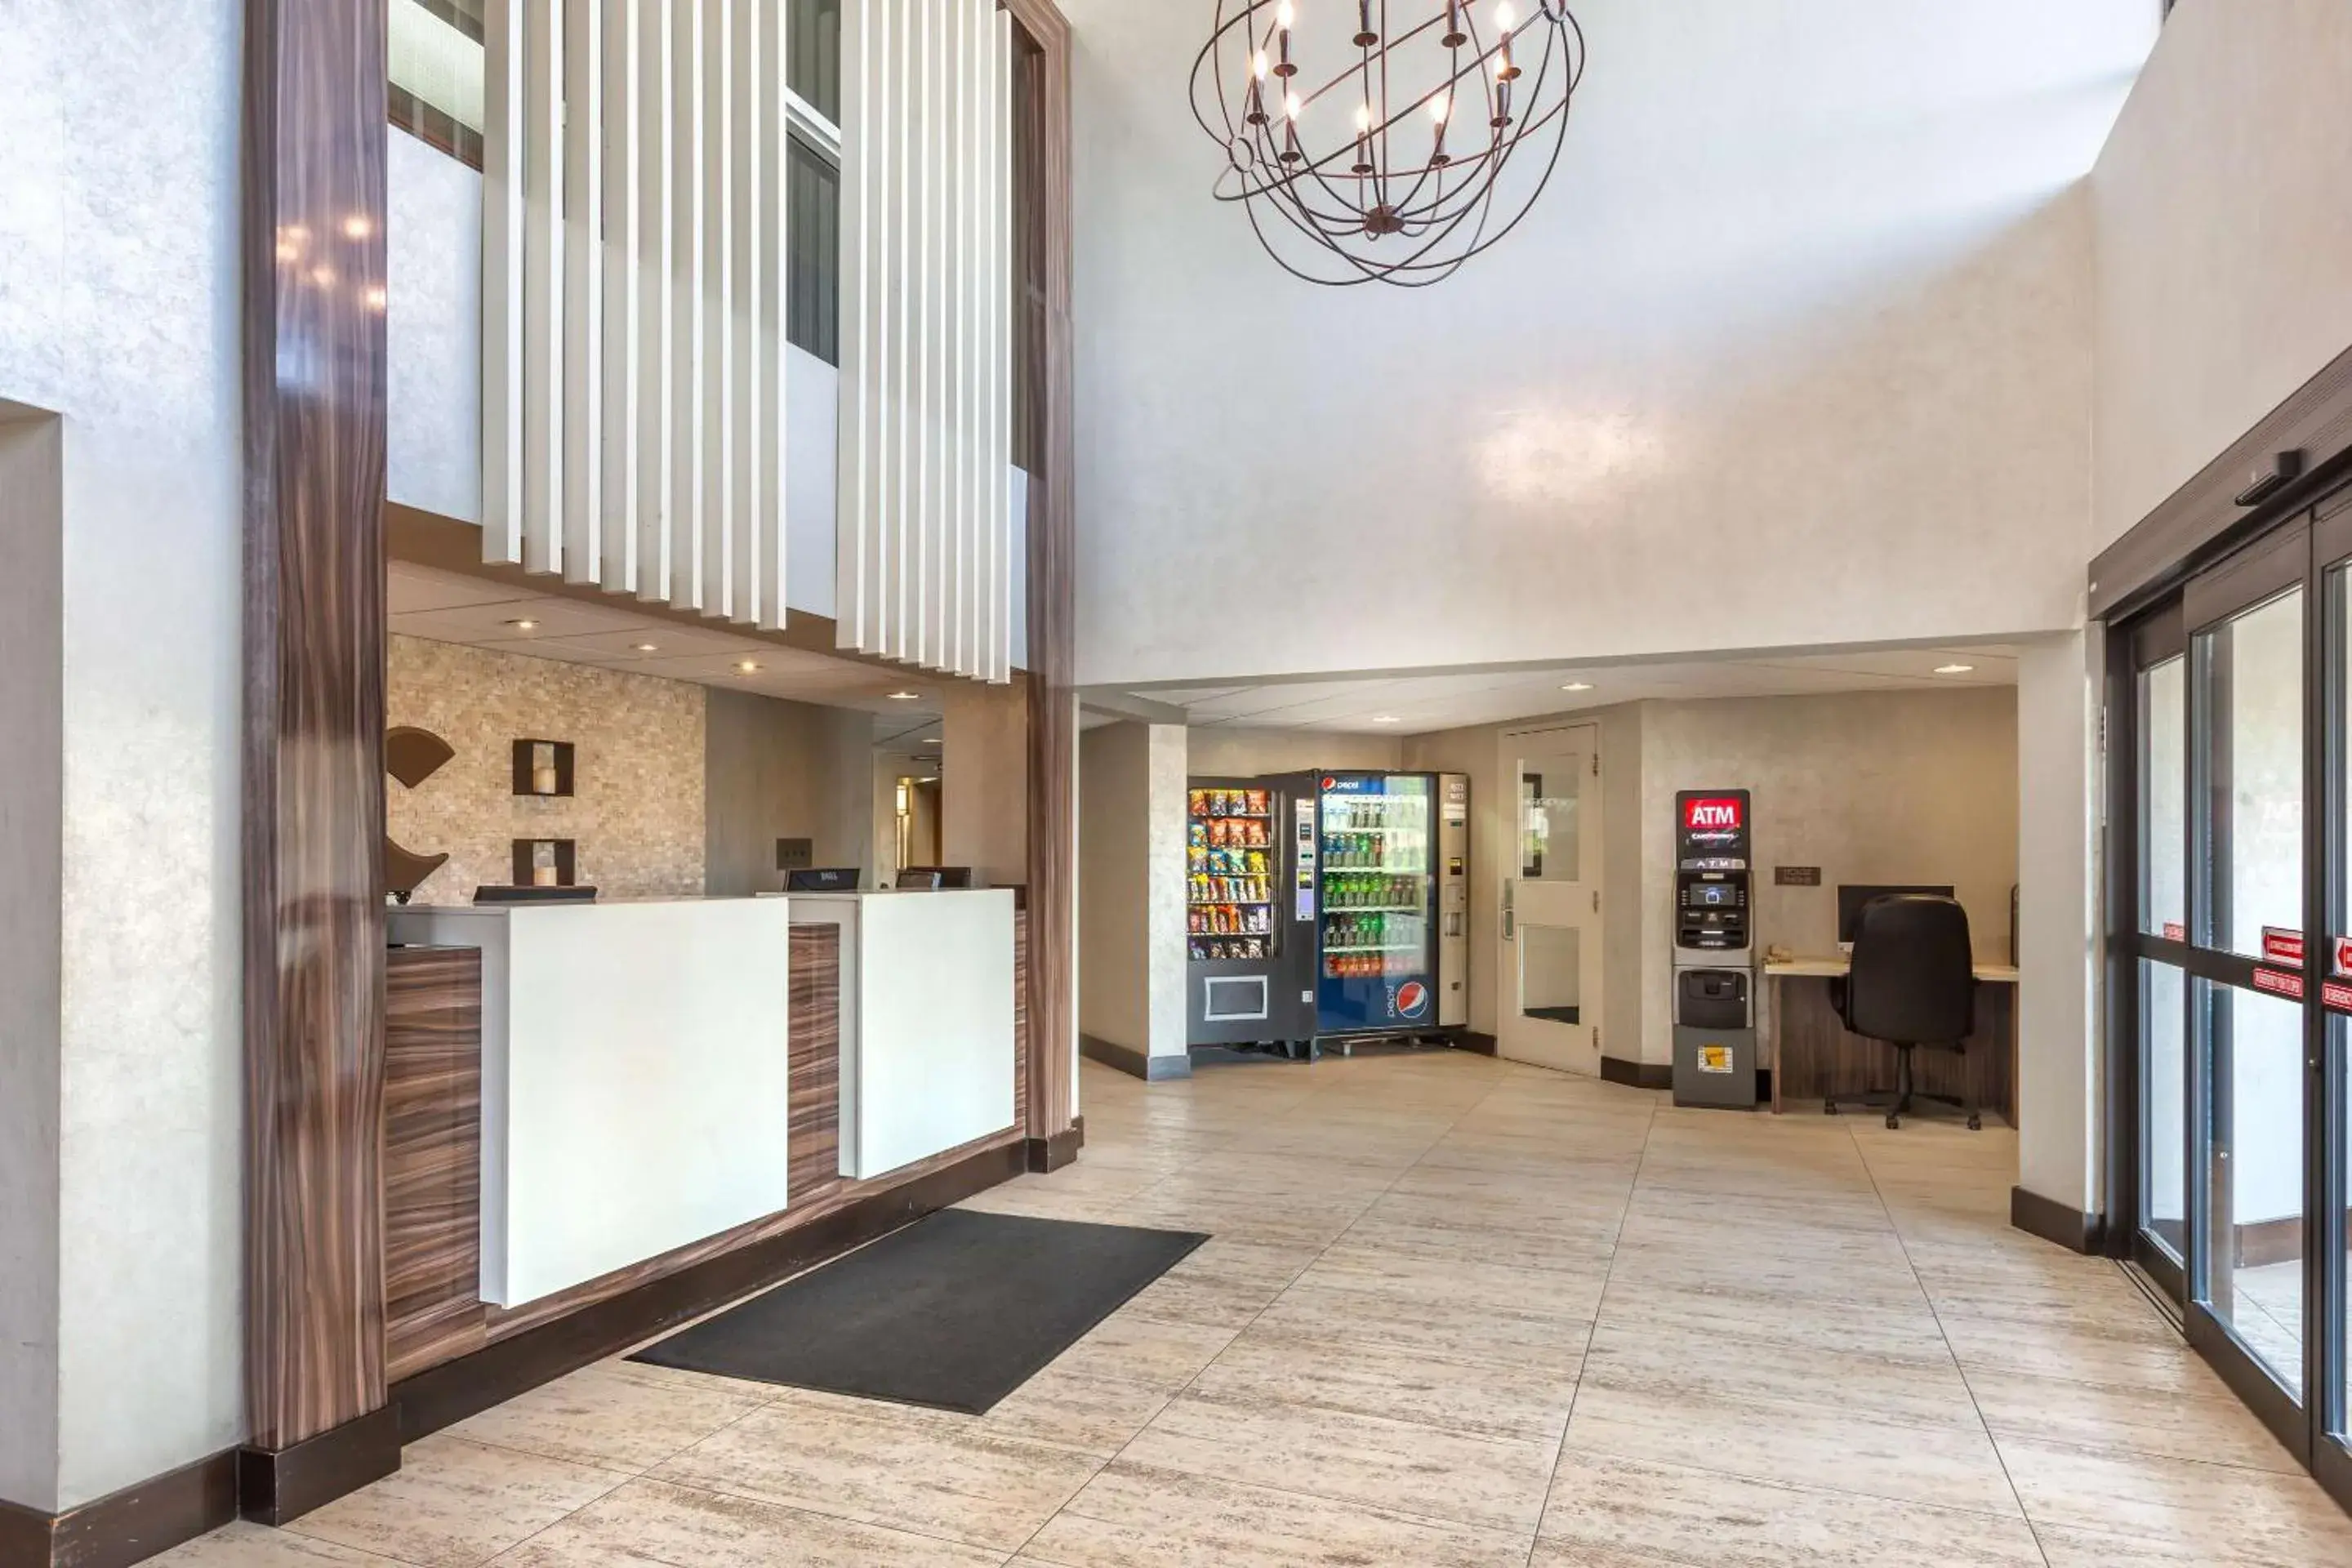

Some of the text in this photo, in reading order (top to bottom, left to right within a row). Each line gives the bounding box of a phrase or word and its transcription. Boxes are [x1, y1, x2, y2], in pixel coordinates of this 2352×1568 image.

[1337, 781, 1359, 791] pepsi
[1691, 805, 1735, 825] ATM
[1696, 859, 1729, 869] ATM
